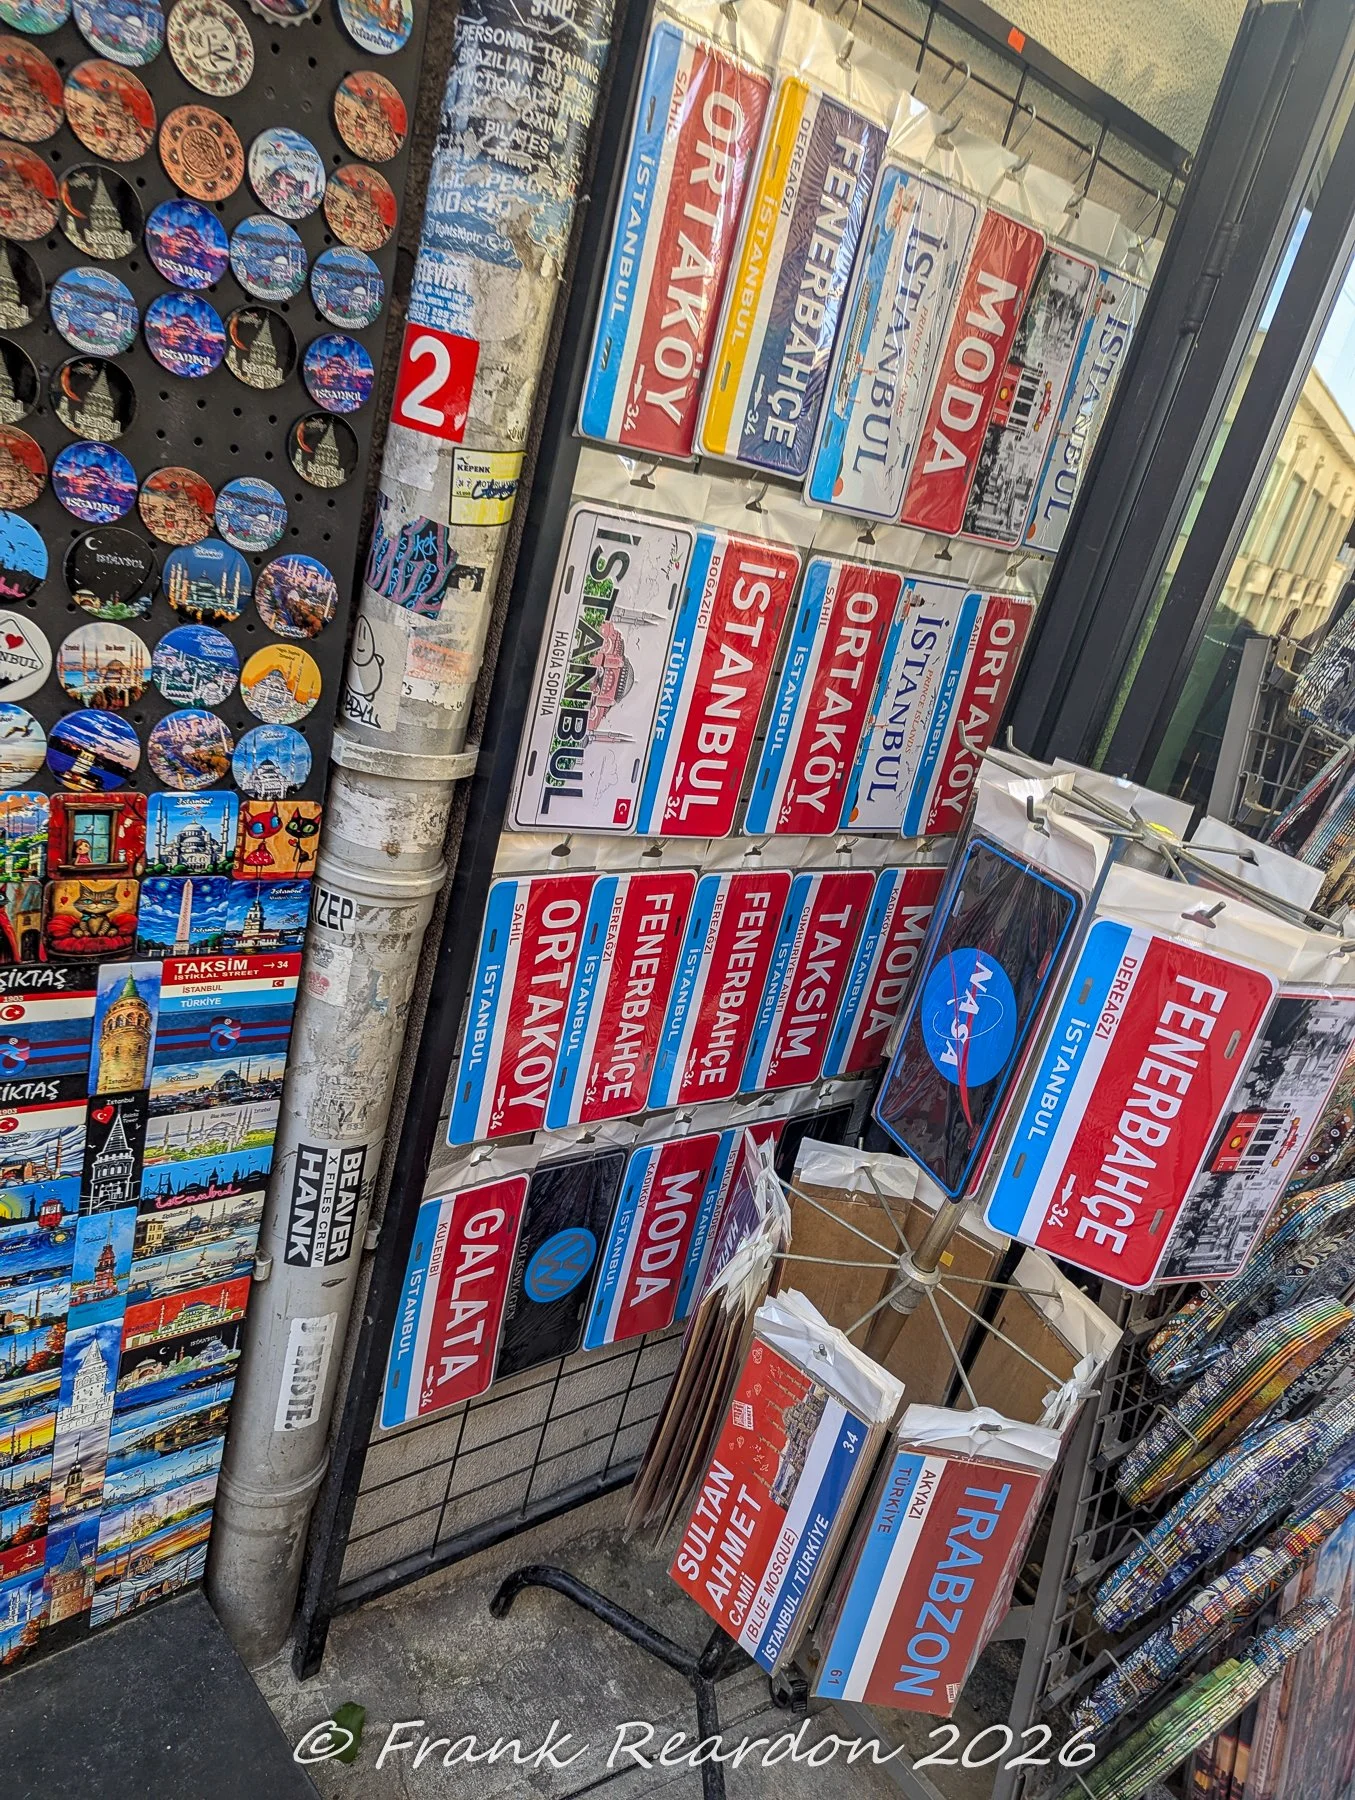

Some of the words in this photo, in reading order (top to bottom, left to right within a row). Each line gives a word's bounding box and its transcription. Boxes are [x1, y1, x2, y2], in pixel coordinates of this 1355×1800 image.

[458, 47, 534, 78] BRAZILIAN
[461, 24, 538, 56] PERSONAL
[538, 42, 600, 84] TRAINING
[485, 119, 550, 153] PILATES
[608, 152, 658, 320] İSTANBUL
[649, 88, 745, 427] ORTAKÖY
[732, 194, 776, 345] İSTANBUL
[765, 134, 870, 451] FENERBAHÇE
[400, 334, 452, 427] 2
[621, 392, 642, 433] 34
[923, 269, 1017, 476] MODA
[743, 406, 760, 437] 34
[456, 463, 491, 474] KEPENK
[550, 630, 570, 669] HAGIA
[678, 560, 787, 821] İSTANBUL
[539, 671, 562, 718] SOPHIA
[770, 645, 809, 757] İSTANBUL
[795, 591, 880, 814] ORTAKÖY
[866, 613, 951, 803] İSTANBUL
[924, 669, 960, 768] İSTANBUL
[663, 795, 681, 820] 34
[778, 804, 793, 825] 34
[926, 807, 939, 827] 34
[174, 958, 248, 974] TAKSİM
[276, 960, 289, 969] 34
[509, 903, 525, 946] SAHİL
[180, 996, 222, 1008] TÜRKİYE
[182, 984, 223, 994] İSTANBUL
[221, 969, 260, 978] STREET
[566, 955, 600, 1057] İSTANBUL
[601, 893, 675, 1103] FENERBAHÇE
[667, 947, 702, 1043] İSTANBUL
[699, 892, 772, 1087] FENERBAHÇE
[758, 942, 792, 1030] İSTANBUL
[781, 904, 852, 1060] TAKSİM
[845, 934, 873, 1018] İSTANBUL
[862, 905, 934, 1041] MODA
[939, 960, 995, 1069] NASA
[1093, 955, 1139, 1042] DEREAĞZI
[468, 964, 502, 1071] İSTANBUL
[584, 1086, 598, 1106] 34
[681, 1069, 695, 1089] 34
[768, 1060, 780, 1077] 34
[1027, 1020, 1092, 1142] İSTANBUL
[490, 1110, 504, 1131] 34
[1074, 974, 1228, 1256] FENERBAHÇE
[321, 1172, 336, 1214] FILES
[328, 1155, 338, 1165] X
[287, 1151, 324, 1265] HANK
[313, 1220, 329, 1263] CREW
[328, 1150, 364, 1262] BEAVER
[630, 1167, 701, 1309] MODA
[688, 1188, 717, 1267] İSTANBUL
[1046, 1201, 1070, 1228] 34
[506, 1233, 532, 1321] VOLKSWAGEN
[603, 1209, 635, 1292] İSTANBUL
[397, 1267, 426, 1361] İSTANBUL
[437, 1207, 505, 1388] GALATA
[421, 1387, 435, 1409] 34
[842, 1430, 859, 1455] 34
[677, 1459, 737, 1583] SULTAN
[877, 1466, 912, 1537] TÜRKİYE
[907, 1469, 937, 1520] AKYAZI
[704, 1483, 765, 1614] AHMET
[745, 1589, 772, 1645] (BLUE
[764, 1526, 801, 1597] MOSQUE)
[761, 1592, 801, 1664] İSTANBUL
[794, 1512, 830, 1587] TÜRKİYE
[893, 1482, 1011, 1698] TRABZON
[728, 1576, 757, 1629] CAMİİ
[827, 1668, 843, 1687] 61
